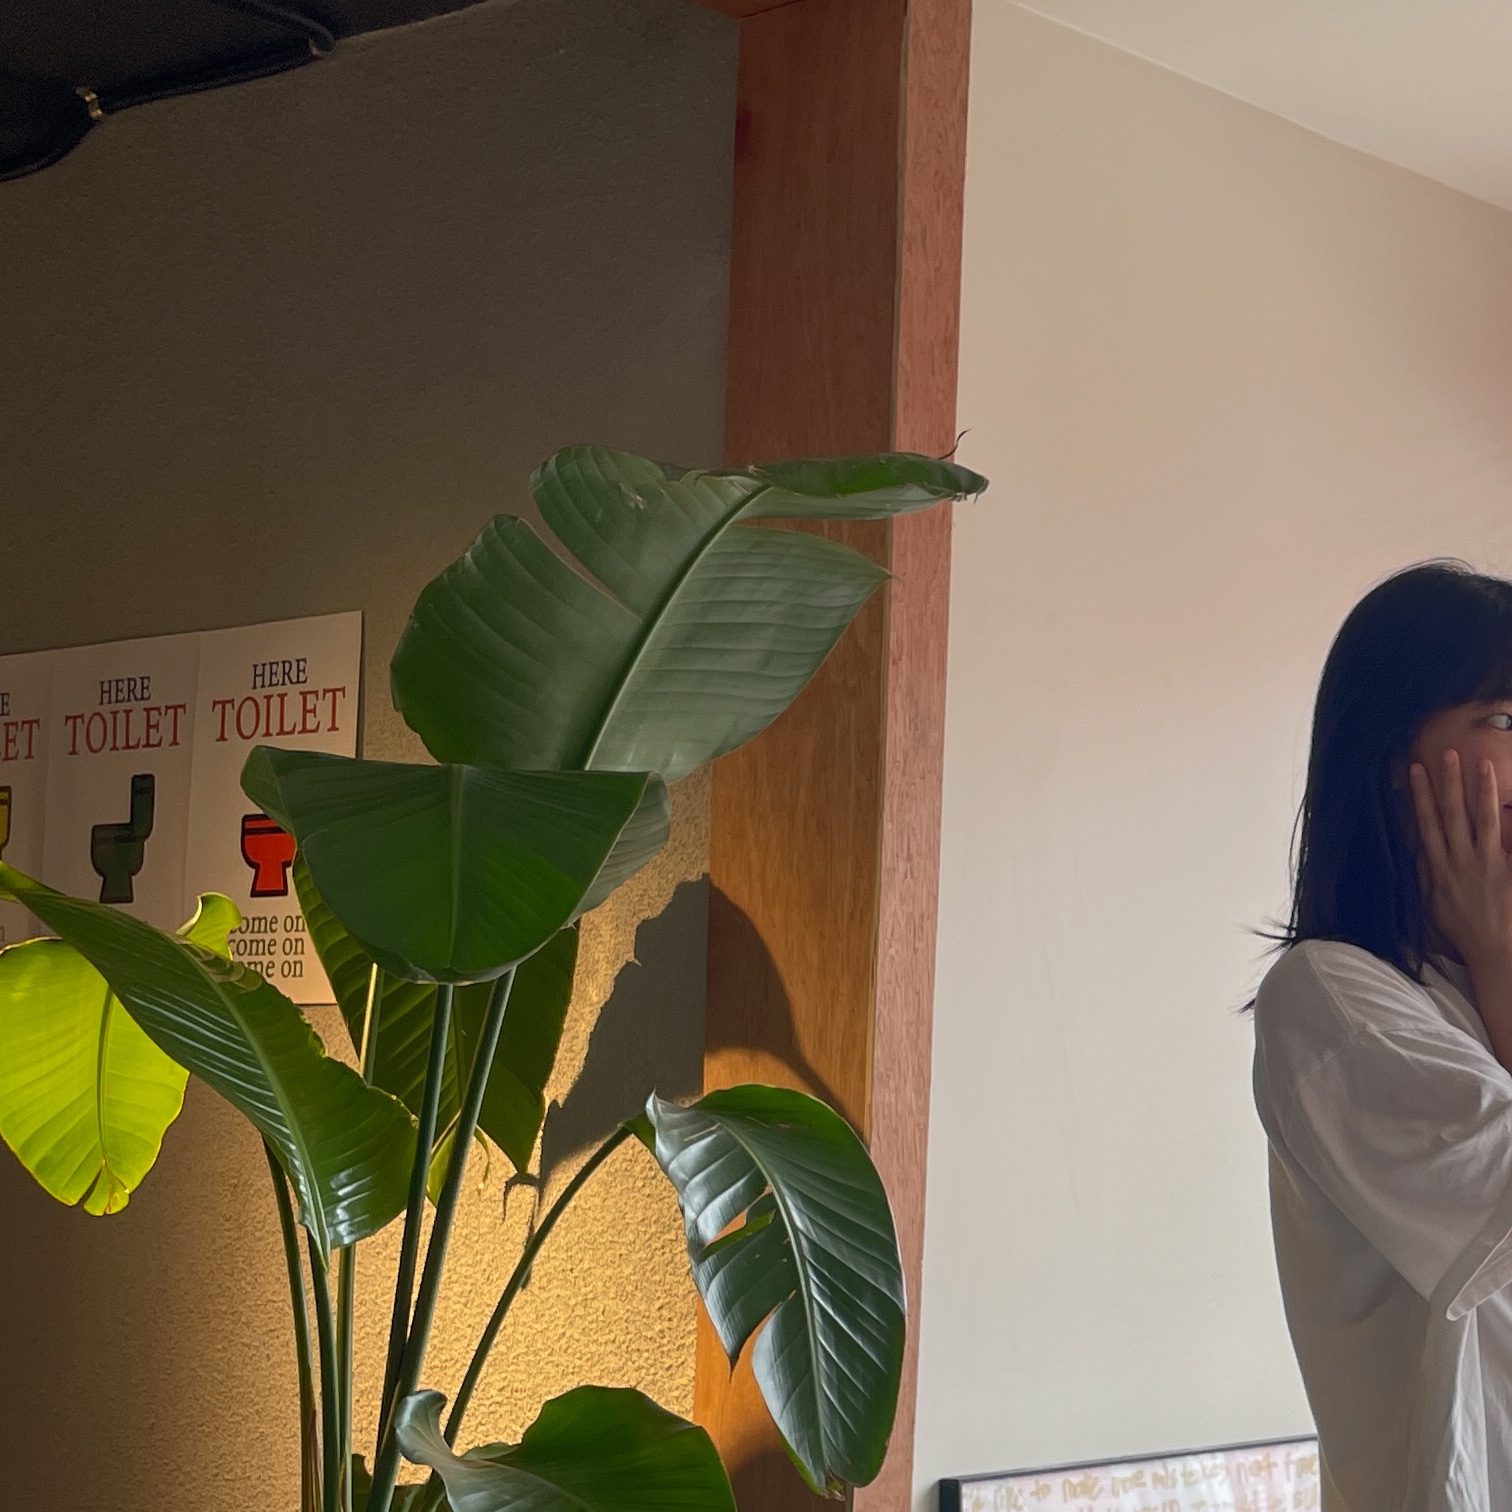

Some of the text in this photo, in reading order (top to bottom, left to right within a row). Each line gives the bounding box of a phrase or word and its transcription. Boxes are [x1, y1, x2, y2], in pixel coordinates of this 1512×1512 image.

[251, 658, 308, 690] HERE
[99, 675, 152, 706] HERE
[211, 686, 346, 743] TOILET
[64, 703, 187, 756] TOILET
[283, 915, 306, 933] on
[282, 937, 305, 956] on
[281, 960, 304, 978] on
[1030, 1478, 1051, 1502] to
